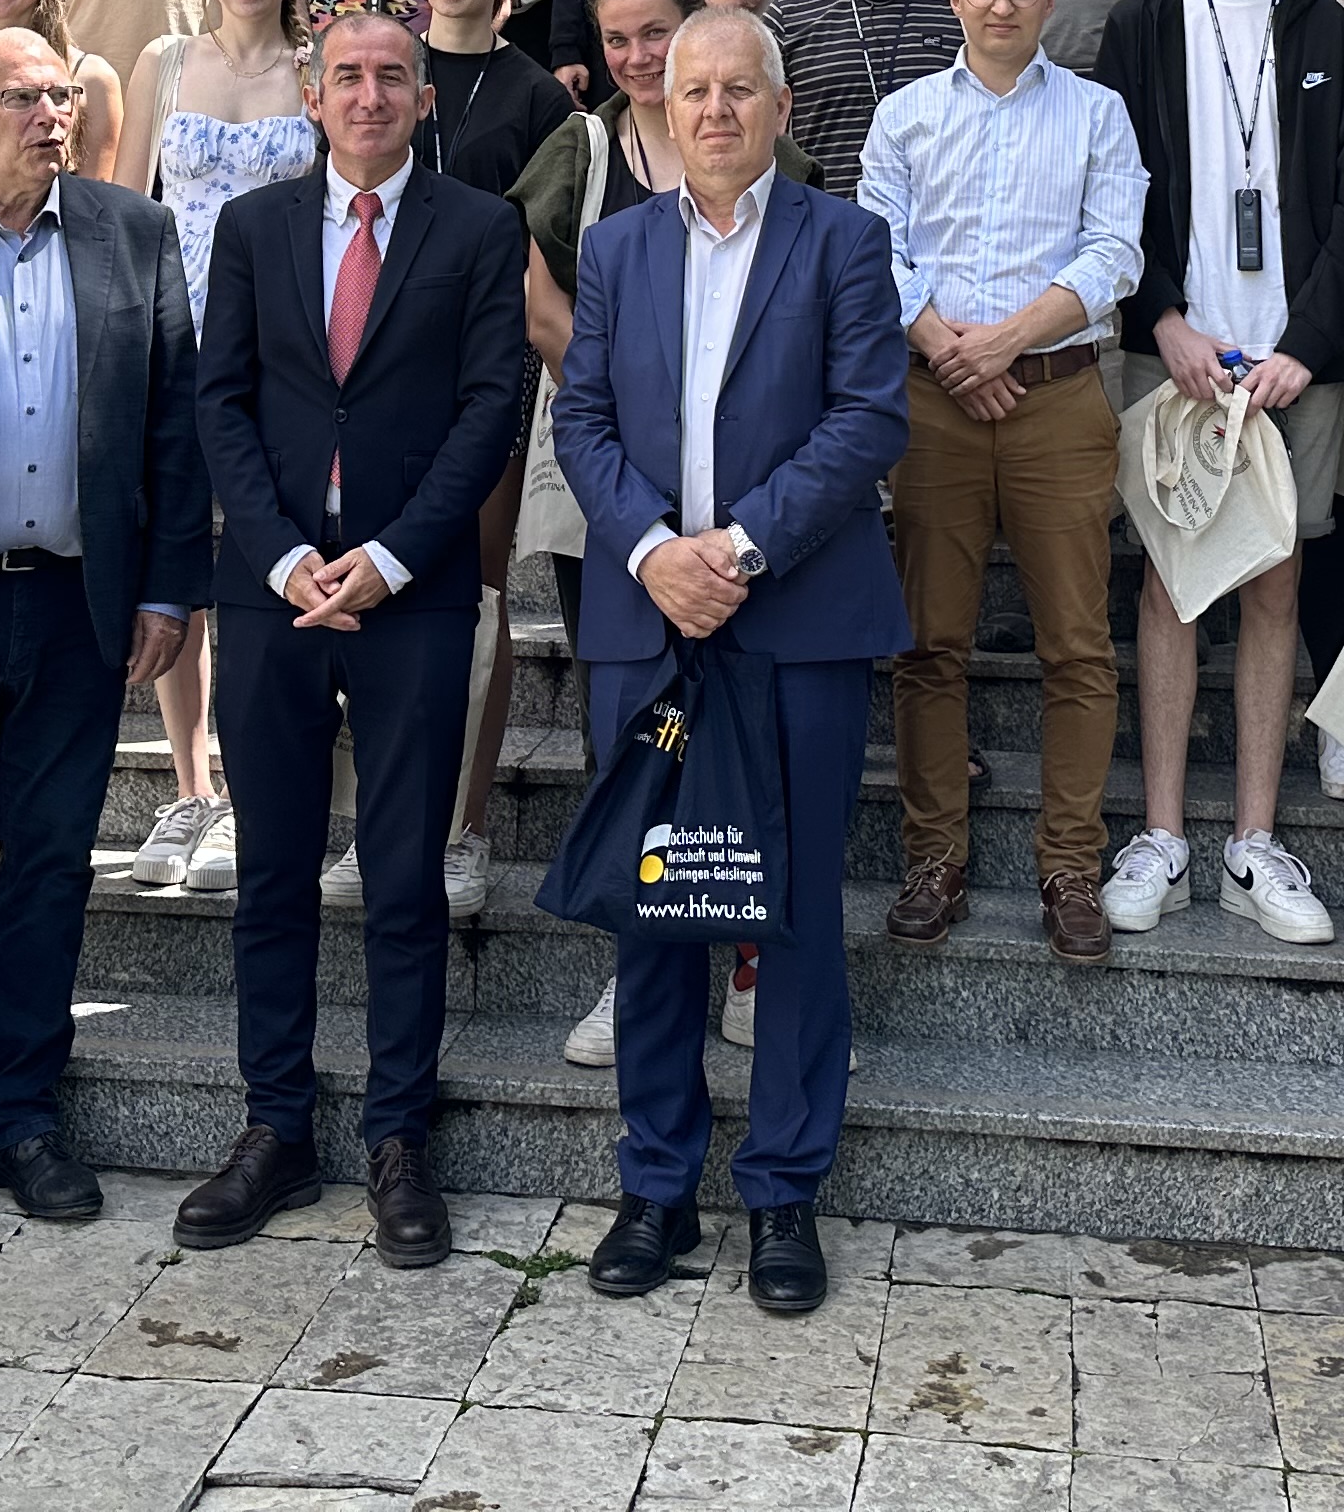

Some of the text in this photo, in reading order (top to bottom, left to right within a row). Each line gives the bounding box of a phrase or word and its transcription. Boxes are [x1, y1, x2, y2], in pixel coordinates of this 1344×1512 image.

[669, 825, 744, 846] ochschule für
[708, 848, 726, 863] und
[636, 893, 768, 920] www.hfwu.de
